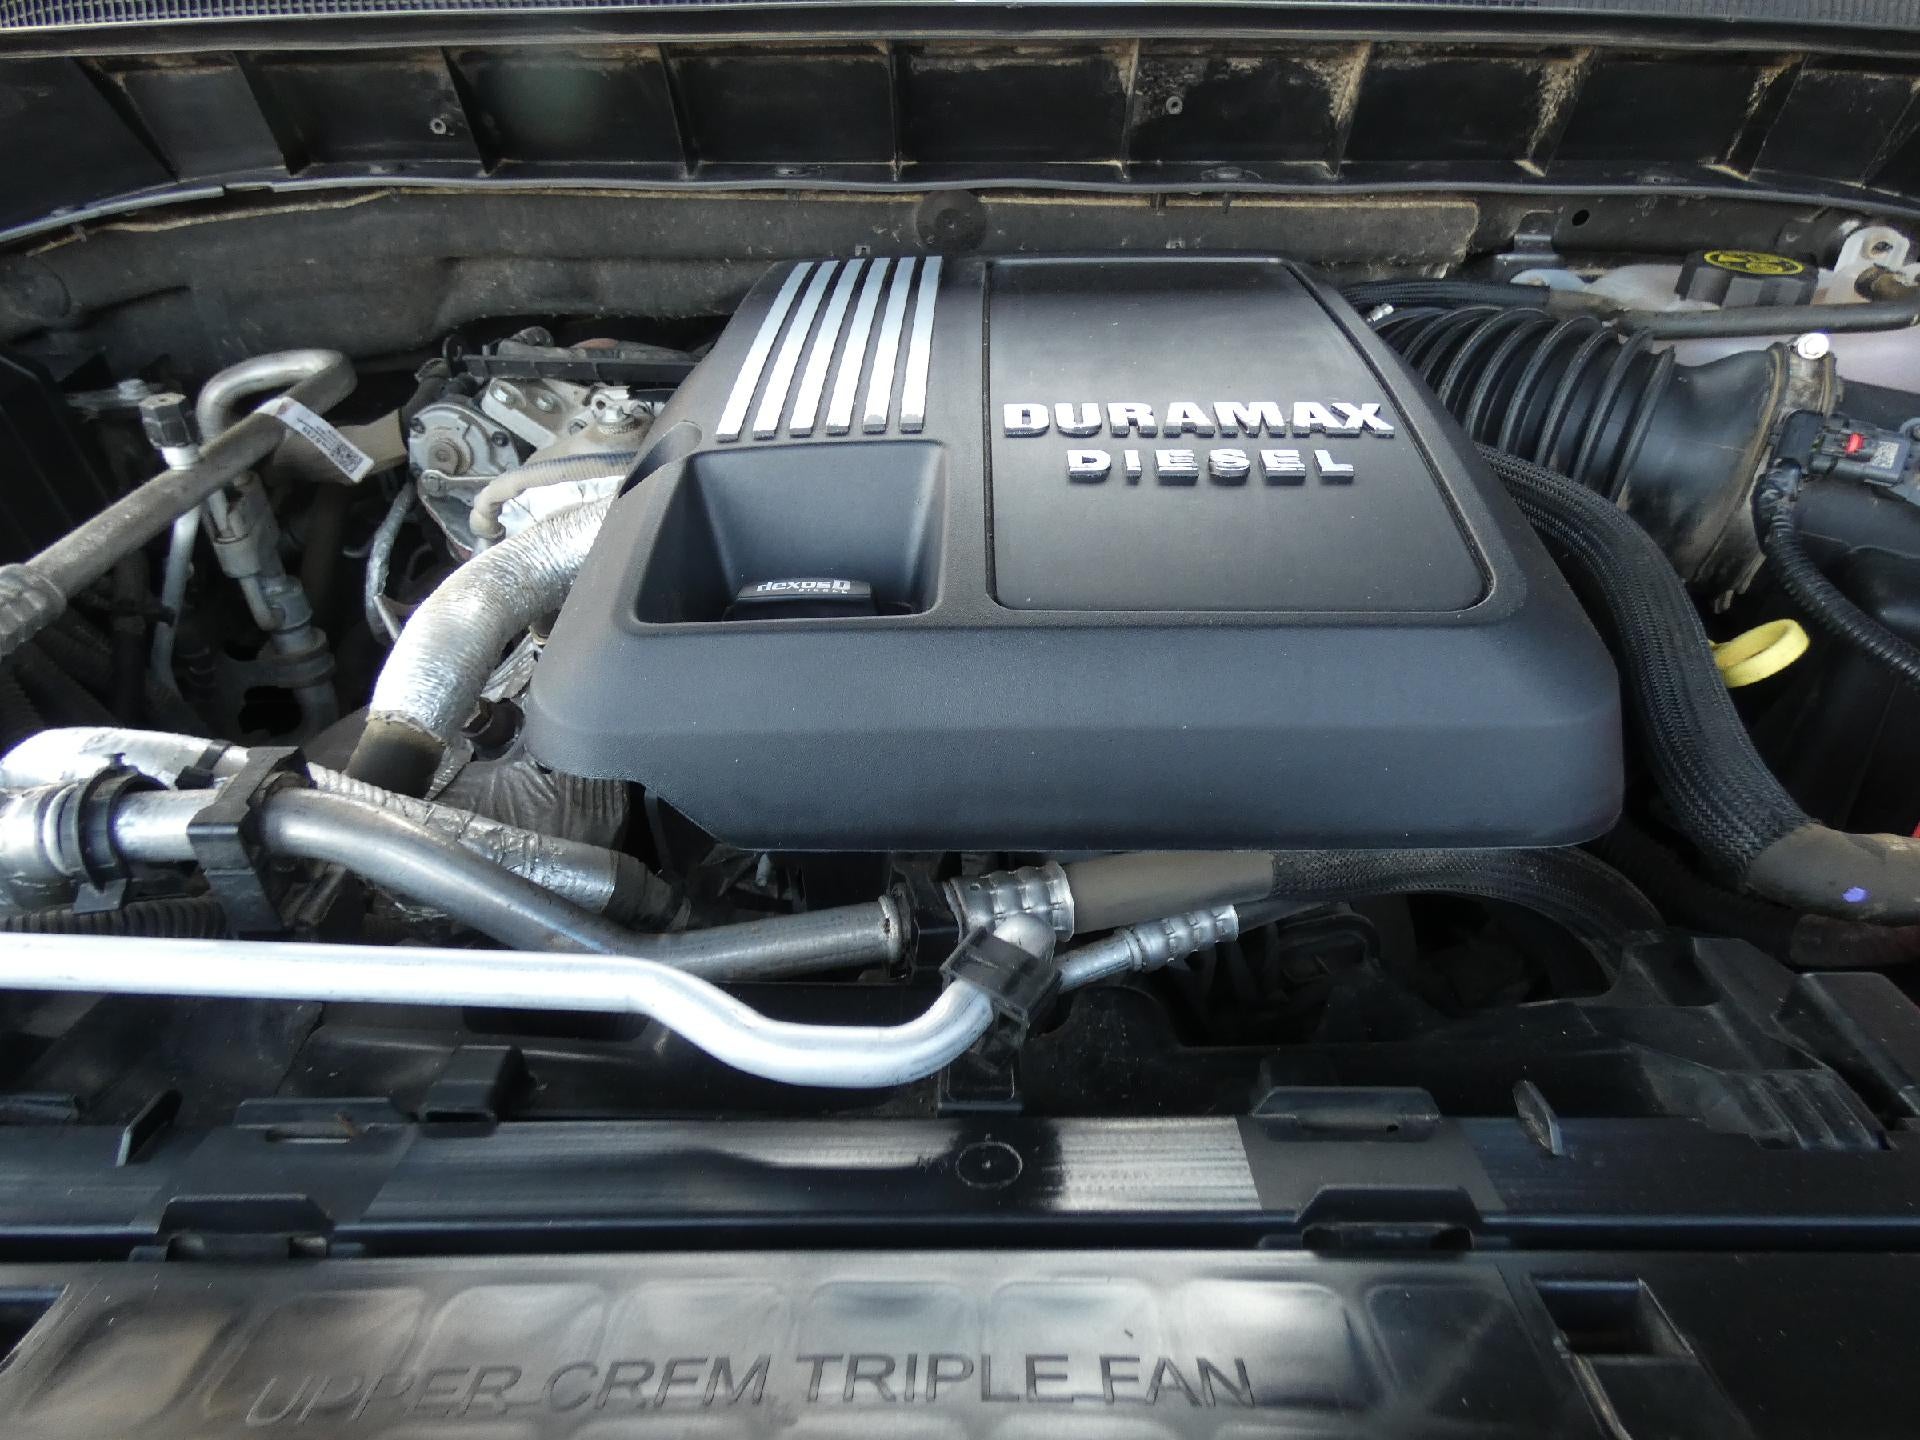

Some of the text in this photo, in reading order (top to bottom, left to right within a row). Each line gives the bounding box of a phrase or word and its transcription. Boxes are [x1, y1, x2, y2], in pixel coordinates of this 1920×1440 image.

[1003, 401, 1395, 438] DURAMAX
[1067, 449, 1355, 481] DIESEL
[245, 1364, 522, 1428] UPPER
[797, 1353, 1074, 1403] TRIPLE
[1099, 1354, 1256, 1408] FAN
